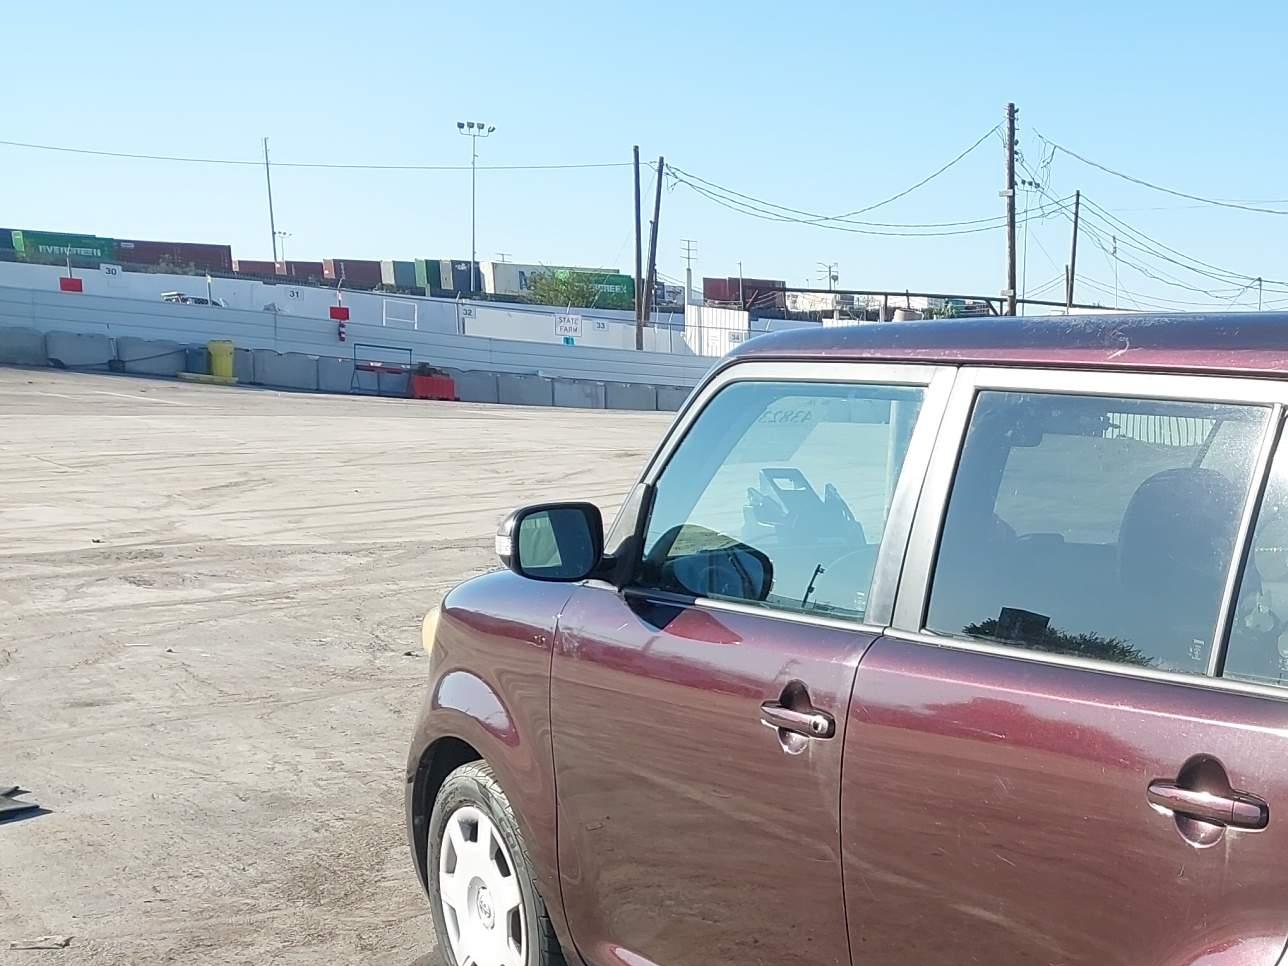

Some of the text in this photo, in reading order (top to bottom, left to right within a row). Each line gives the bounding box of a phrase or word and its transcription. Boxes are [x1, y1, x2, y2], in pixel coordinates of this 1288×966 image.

[105, 267, 117, 276] 30
[289, 290, 299, 298] 31
[463, 308, 473, 317] 32
[558, 316, 579, 325] STATE
[559, 325, 579, 333] FARM
